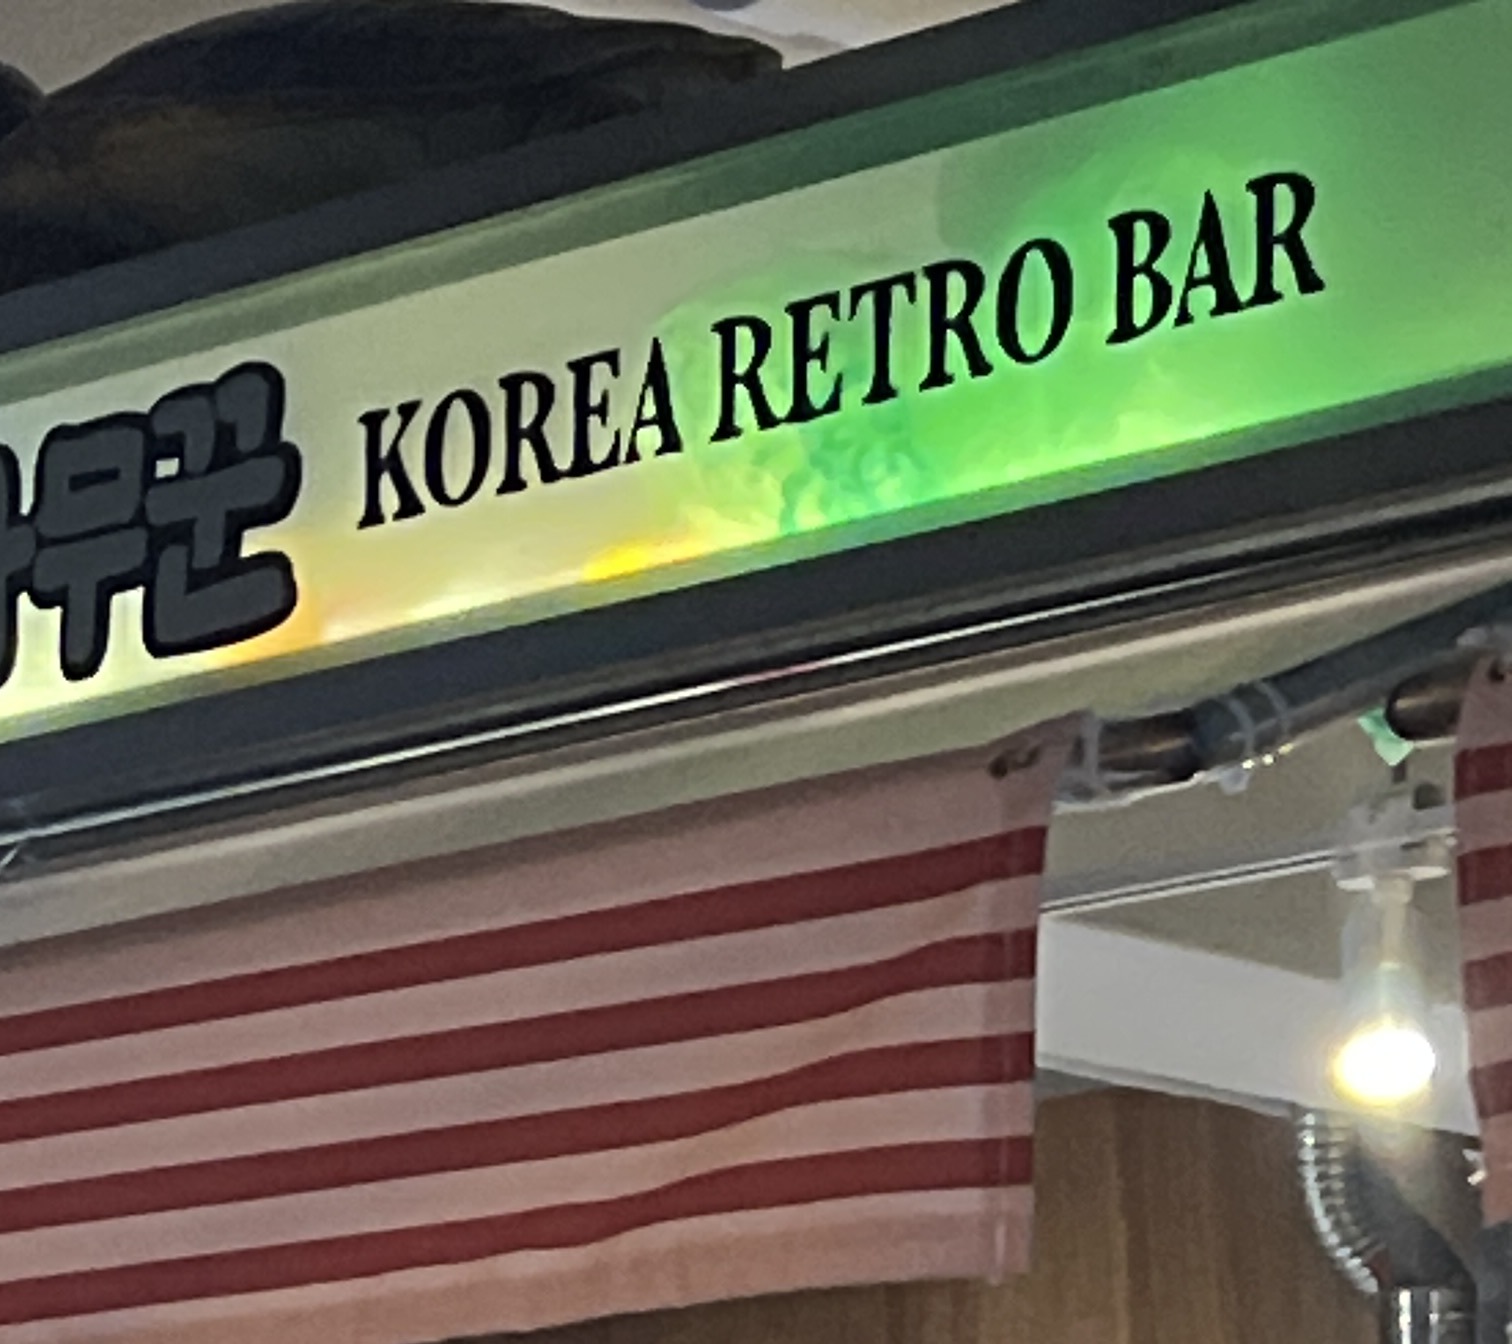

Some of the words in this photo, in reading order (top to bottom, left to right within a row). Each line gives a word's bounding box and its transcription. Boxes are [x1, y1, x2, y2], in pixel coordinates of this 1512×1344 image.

[356, 337, 683, 529] KOREA
[710, 236, 1075, 442] RETRO
[1105, 171, 1325, 345] BAR
